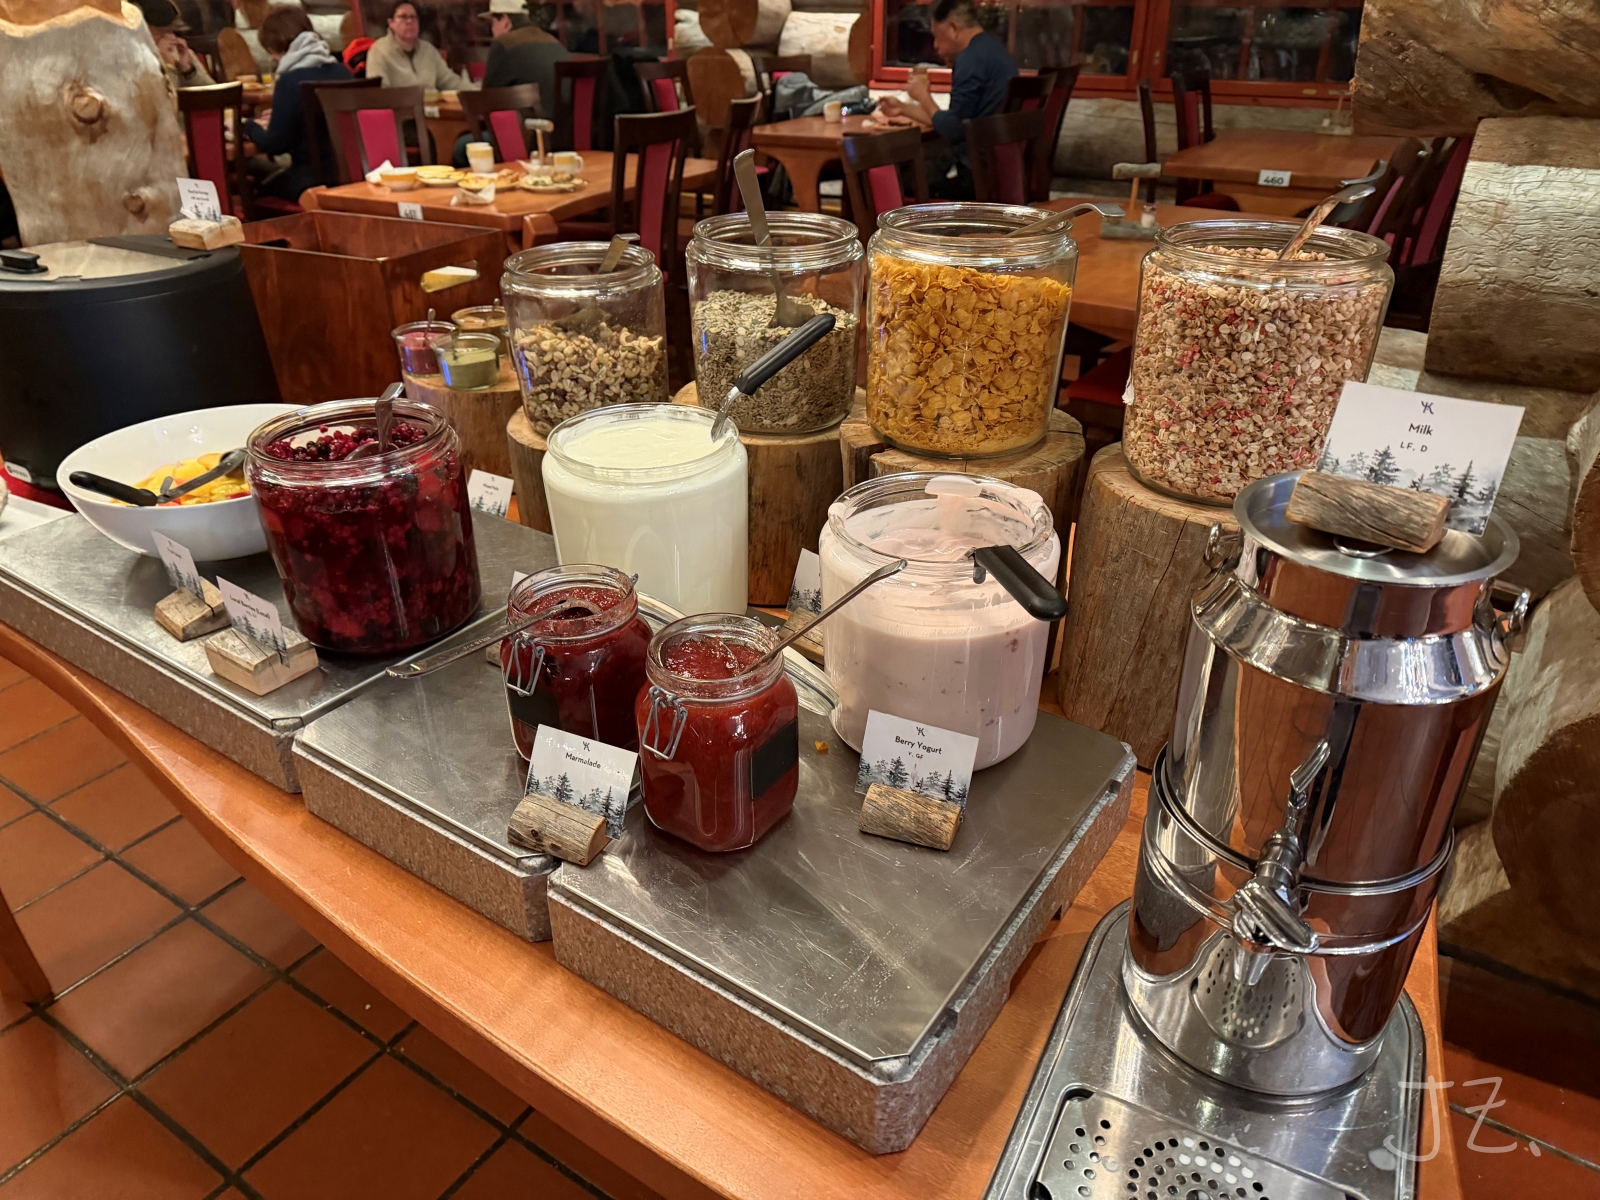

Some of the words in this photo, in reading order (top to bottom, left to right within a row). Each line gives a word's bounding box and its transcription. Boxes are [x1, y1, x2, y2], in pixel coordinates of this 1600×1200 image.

[1263, 176, 1284, 185] 460
[1408, 422, 1433, 436] Milk
[1400, 441, 1415, 451] LF,
[894, 735, 916, 749] Berry
[916, 741, 943, 754] Yogurt
[565, 752, 601, 769] Marmalade
